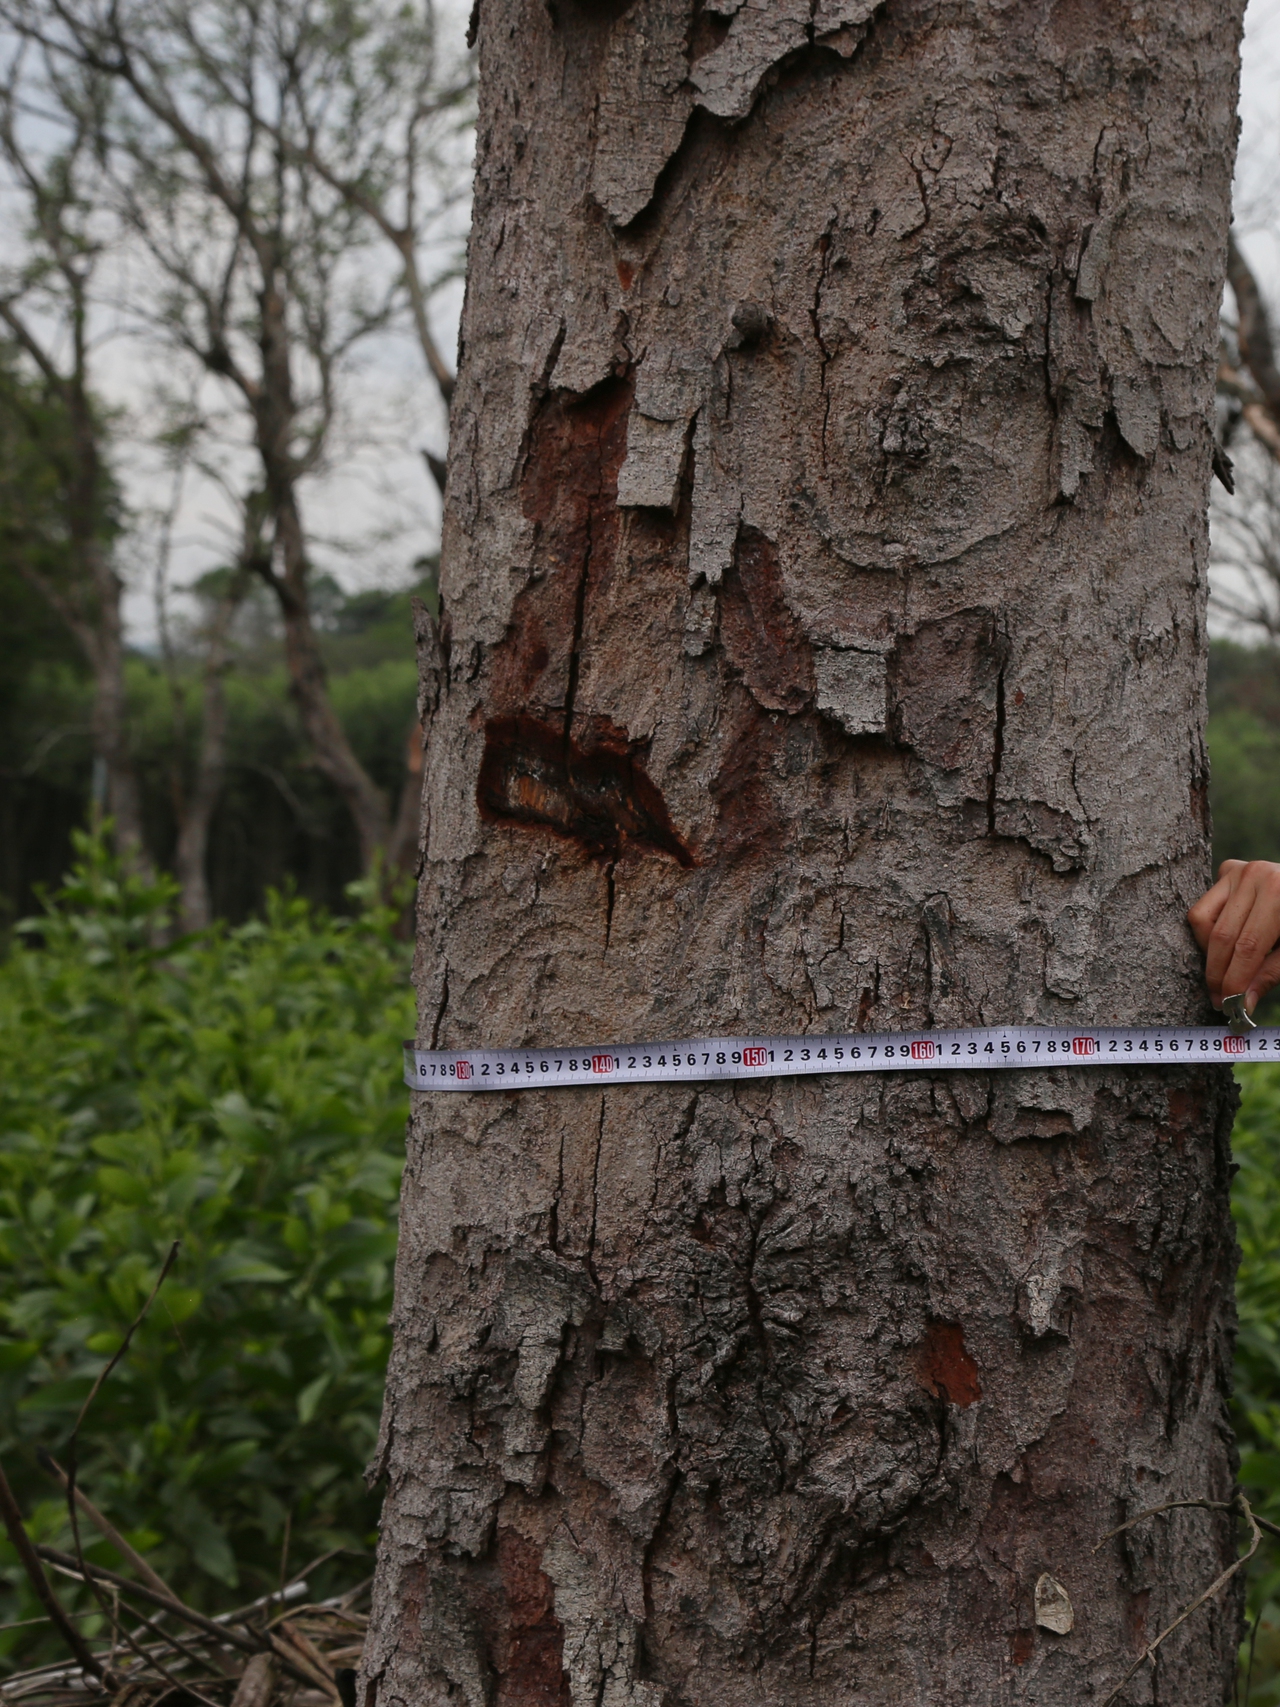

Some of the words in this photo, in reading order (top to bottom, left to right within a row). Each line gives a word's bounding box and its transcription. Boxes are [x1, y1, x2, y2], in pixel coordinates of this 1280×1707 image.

[420, 1064, 426, 1076] 6
[430, 1065, 436, 1076] 7
[440, 1064, 447, 1076] 8
[449, 1064, 455, 1076] 9
[458, 1063, 469, 1078] 130
[470, 1065, 474, 1075] 1
[481, 1064, 490, 1076] 2
[496, 1063, 505, 1075] 3
[511, 1062, 520, 1073] 4
[526, 1062, 534, 1073] 5
[540, 1061, 549, 1072] 6
[554, 1060, 562, 1072] 7
[569, 1059, 578, 1071] 8
[583, 1059, 591, 1071] 9
[594, 1057, 612, 1072] 140
[614, 1058, 620, 1069] 1
[628, 1057, 636, 1068] 2
[643, 1056, 652, 1068] 3
[658, 1055, 667, 1067] 4
[672, 1055, 681, 1066] 5
[687, 1054, 696, 1065] 6
[702, 1053, 710, 1065] 7
[716, 1052, 726, 1064] 8
[732, 1052, 741, 1063] 9
[745, 1049, 766, 1065] 150
[768, 1051, 774, 1062] 1
[784, 1050, 793, 1061] 2
[801, 1049, 810, 1061] 3
[818, 1049, 827, 1060] 4
[834, 1048, 843, 1059] 5
[851, 1047, 861, 1058] 6
[868, 1047, 877, 1058] 7
[884, 1046, 894, 1057] 8
[900, 1045, 910, 1057] 9
[913, 1043, 933, 1058] 160
[936, 1044, 942, 1055] 1
[952, 1043, 960, 1055] 2
[968, 1043, 977, 1054] 3
[984, 1042, 994, 1053] 4
[1001, 1041, 1010, 1053] 5
[1017, 1041, 1026, 1052] 6
[1032, 1041, 1041, 1052] 7
[1048, 1041, 1056, 1052] 8
[1062, 1041, 1070, 1052] 9
[1074, 1039, 1093, 1054] 170
[1095, 1041, 1100, 1051] 1
[1109, 1040, 1117, 1051] 2
[1124, 1040, 1132, 1051] 3
[1139, 1040, 1148, 1051] 4
[1155, 1040, 1163, 1051] 5
[1170, 1040, 1178, 1051] 6
[1185, 1040, 1193, 1051] 7
[1200, 1039, 1208, 1051] 8
[1213, 1039, 1222, 1051] 9
[1225, 1038, 1244, 1052] 180
[1245, 1040, 1250, 1050] 1
[1259, 1039, 1267, 1050] 2
